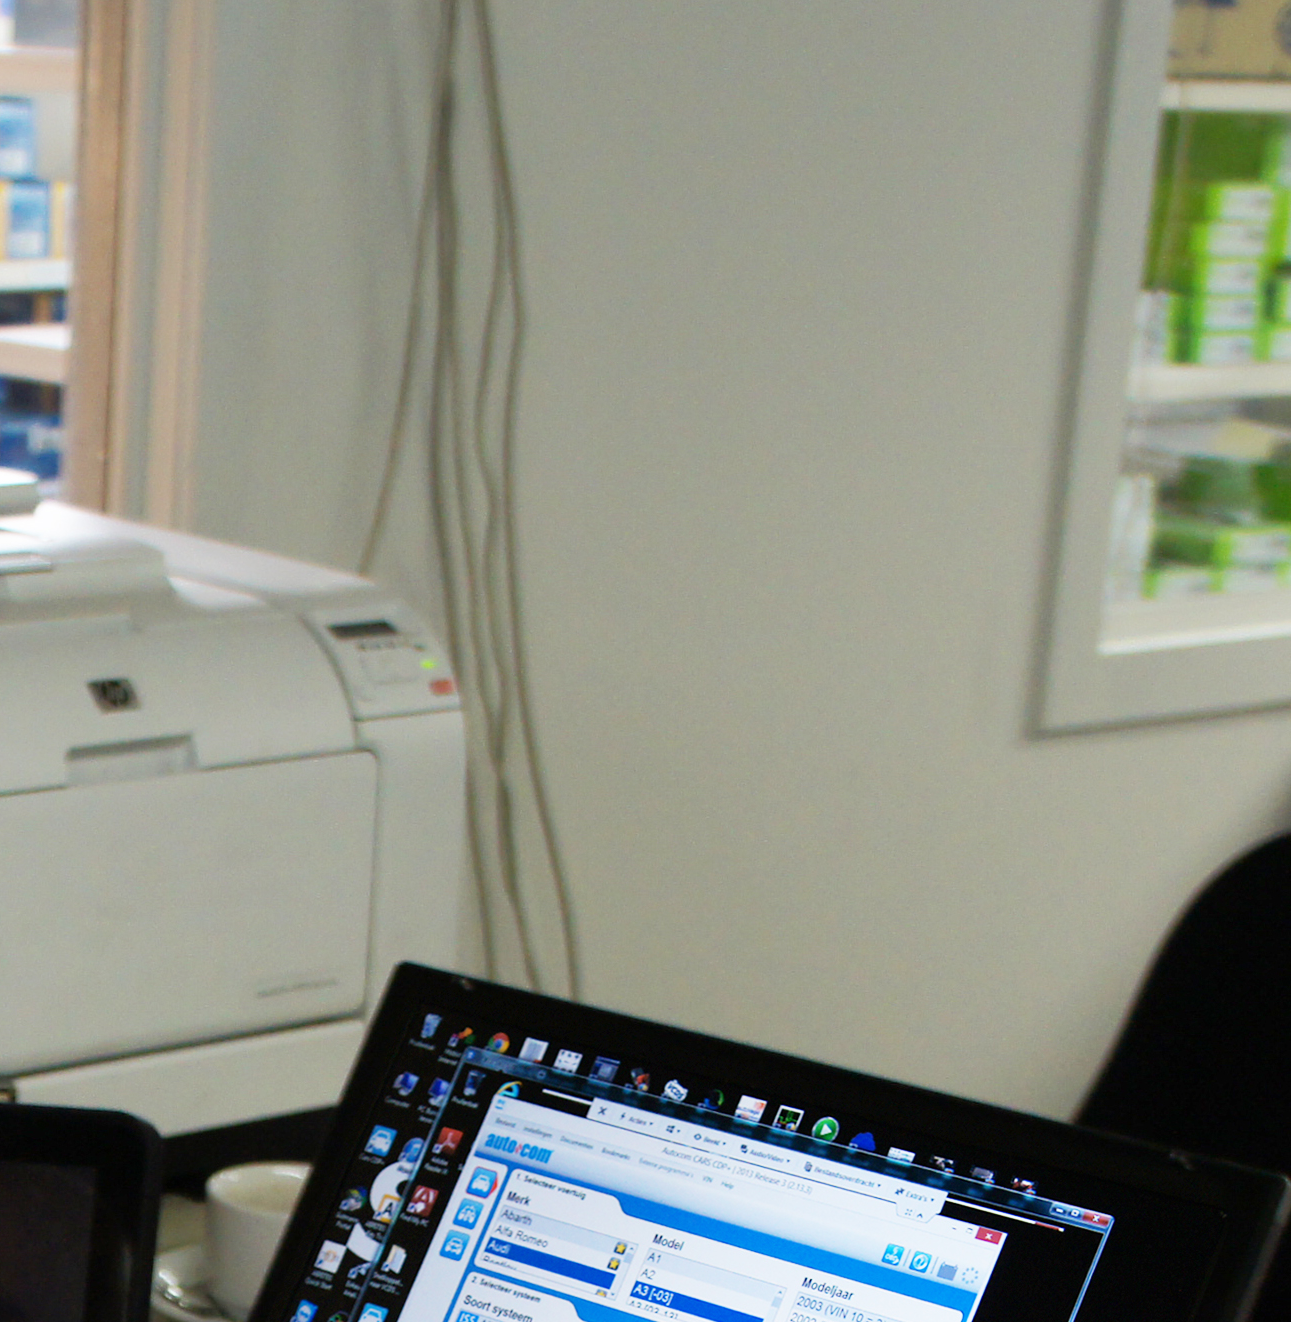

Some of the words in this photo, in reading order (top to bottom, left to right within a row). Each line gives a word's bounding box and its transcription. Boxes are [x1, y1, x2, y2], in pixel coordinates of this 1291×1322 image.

[661, 1147, 692, 1161] Autocom
[692, 1155, 712, 1167] CARS
[736, 1167, 755, 1179] 2013
[755, 1172, 781, 1187] Release
[523, 1174, 557, 1191] Selecteer
[557, 1185, 587, 1200] voertuig
[507, 1190, 532, 1207] Merk
[501, 1208, 533, 1226] Abarth
[495, 1223, 514, 1238] Alfa
[516, 1229, 548, 1248] Romeo
[652, 1233, 685, 1251] Model
[487, 1240, 512, 1255] Audi
[647, 1252, 662, 1264] A1
[640, 1268, 656, 1281] A2
[479, 1277, 512, 1294] Selecteer
[512, 1289, 541, 1303] systeem
[633, 1284, 649, 1297] A3
[648, 1288, 674, 1306] [-03]
[801, 1277, 855, 1301] Modeljaar
[463, 1294, 491, 1312] Soort
[796, 1295, 823, 1312] 2003
[824, 1303, 849, 1320] (VIN
